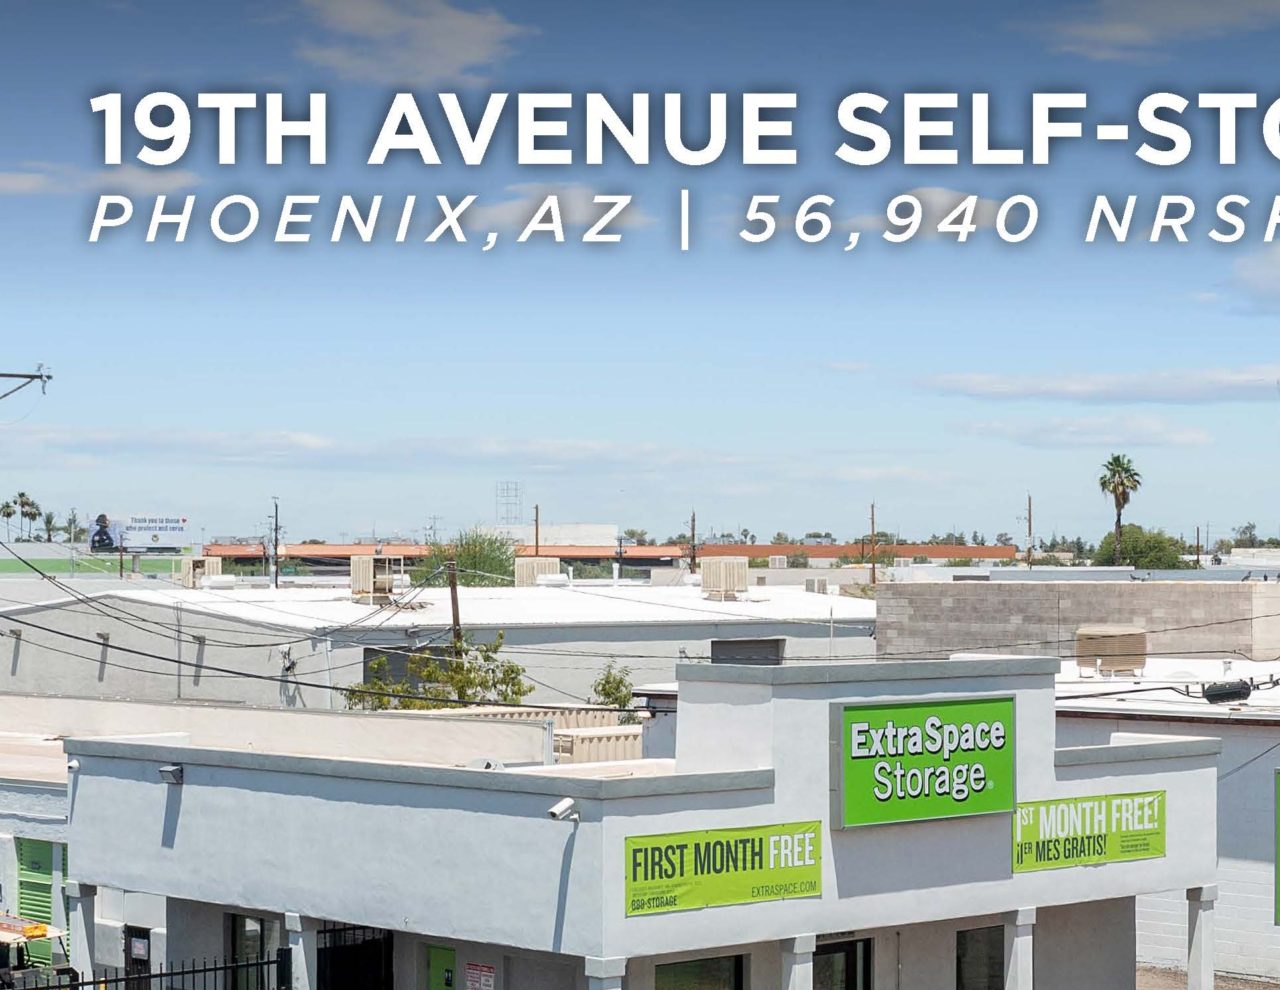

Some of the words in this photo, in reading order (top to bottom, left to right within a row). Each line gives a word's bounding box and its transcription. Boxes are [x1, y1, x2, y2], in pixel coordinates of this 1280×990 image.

[851, 716, 1005, 760] ExtraSpace
[1039, 800, 1107, 839] MONTH
[1111, 796, 1161, 833] FREE!
[632, 844, 688, 882] FIRST
[694, 837, 763, 876] MONTH
[769, 832, 816, 869] FREE
[1035, 839, 1061, 862] MES
[1063, 834, 1107, 859] GRATIS!
